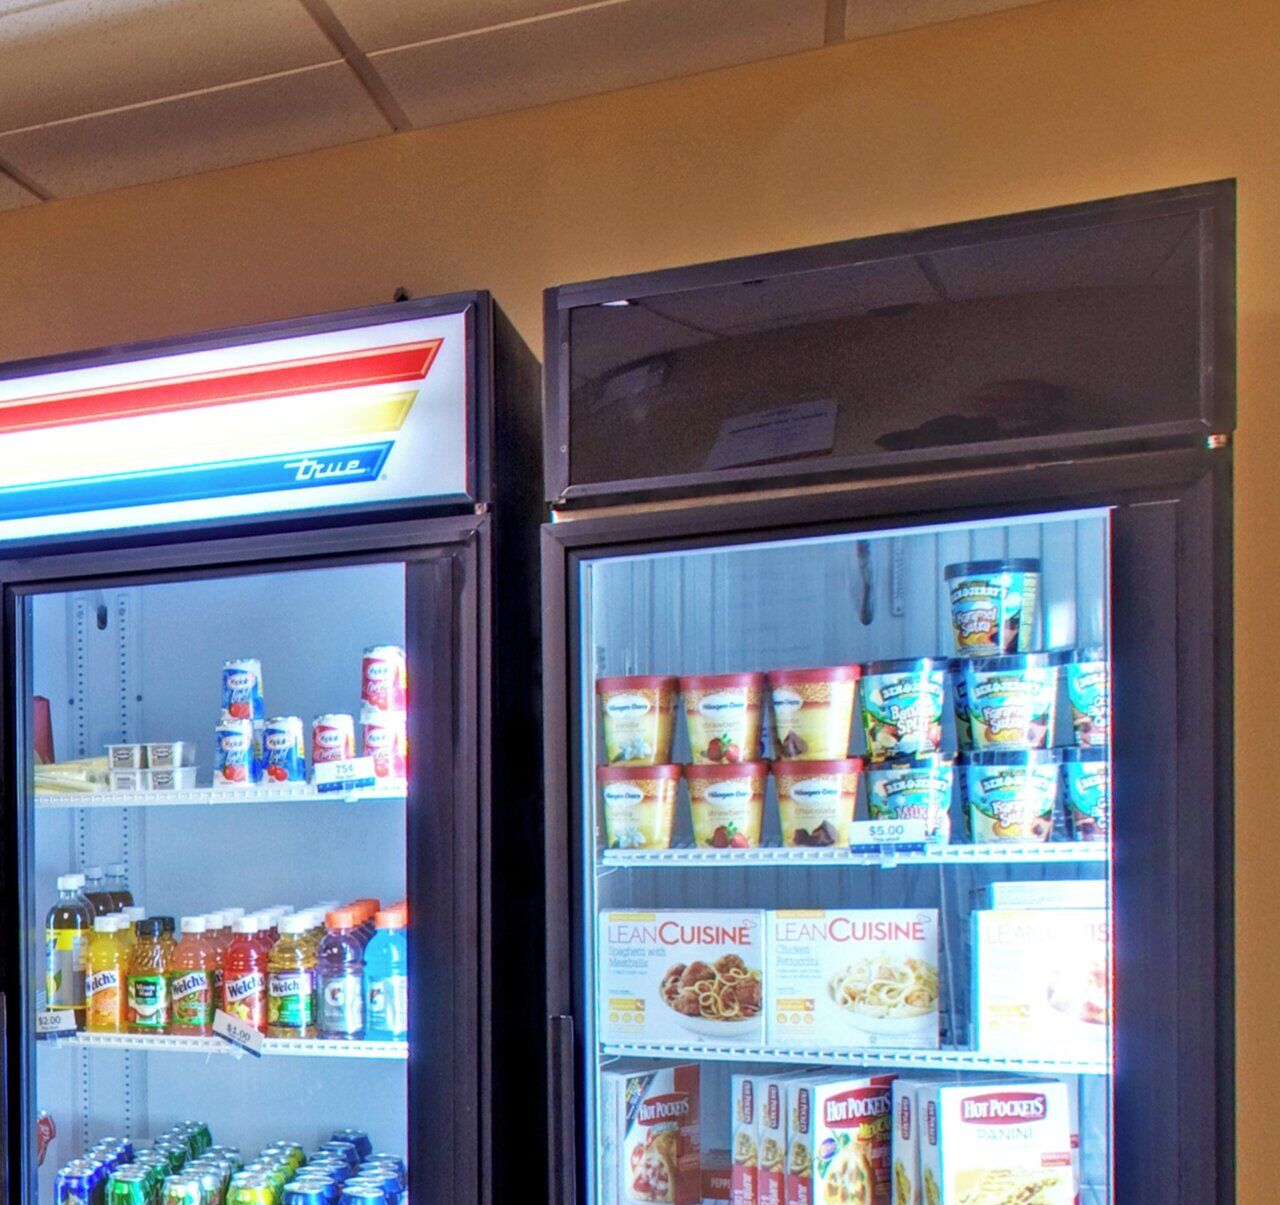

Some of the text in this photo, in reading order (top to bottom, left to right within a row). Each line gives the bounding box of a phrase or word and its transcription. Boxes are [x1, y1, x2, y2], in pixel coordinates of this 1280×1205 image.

[869, 825, 904, 836] $5.00
[608, 921, 751, 945] LEAN CUISINE
[775, 917, 926, 942] LEAN CUISINE
[172, 975, 205, 994] Welch's
[38, 1016, 61, 1026] $2.00
[827, 1092, 890, 1122] HOT POCKETS
[964, 1097, 1044, 1119] HOT POCKETS
